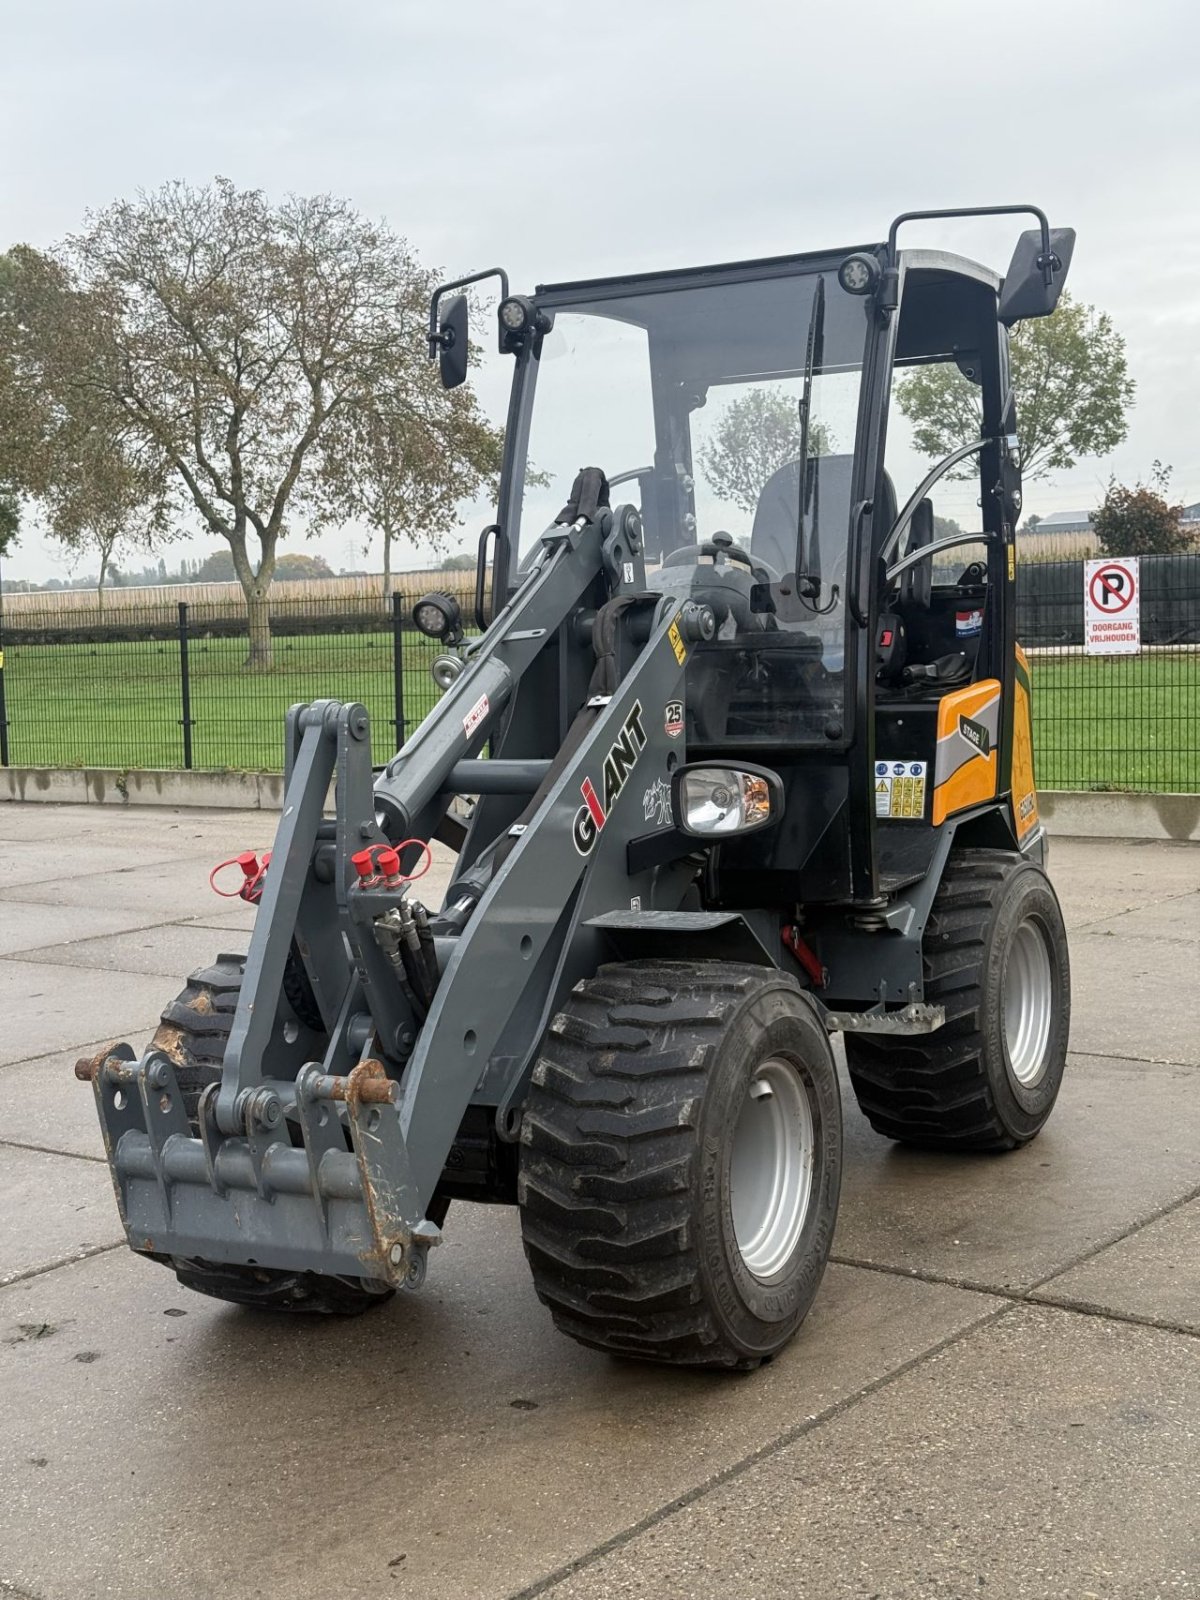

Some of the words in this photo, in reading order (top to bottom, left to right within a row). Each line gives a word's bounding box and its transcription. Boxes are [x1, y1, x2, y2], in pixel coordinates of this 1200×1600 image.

[1102, 574, 1124, 605] P
[1089, 633, 1136, 643] VRIJHOUDEN
[1092, 622, 1133, 632] DOORGANG
[667, 704, 681, 724] 25
[963, 723, 980, 745] STAGE
[573, 698, 648, 857] GIANT
[704, 1213, 723, 1277] POWER
